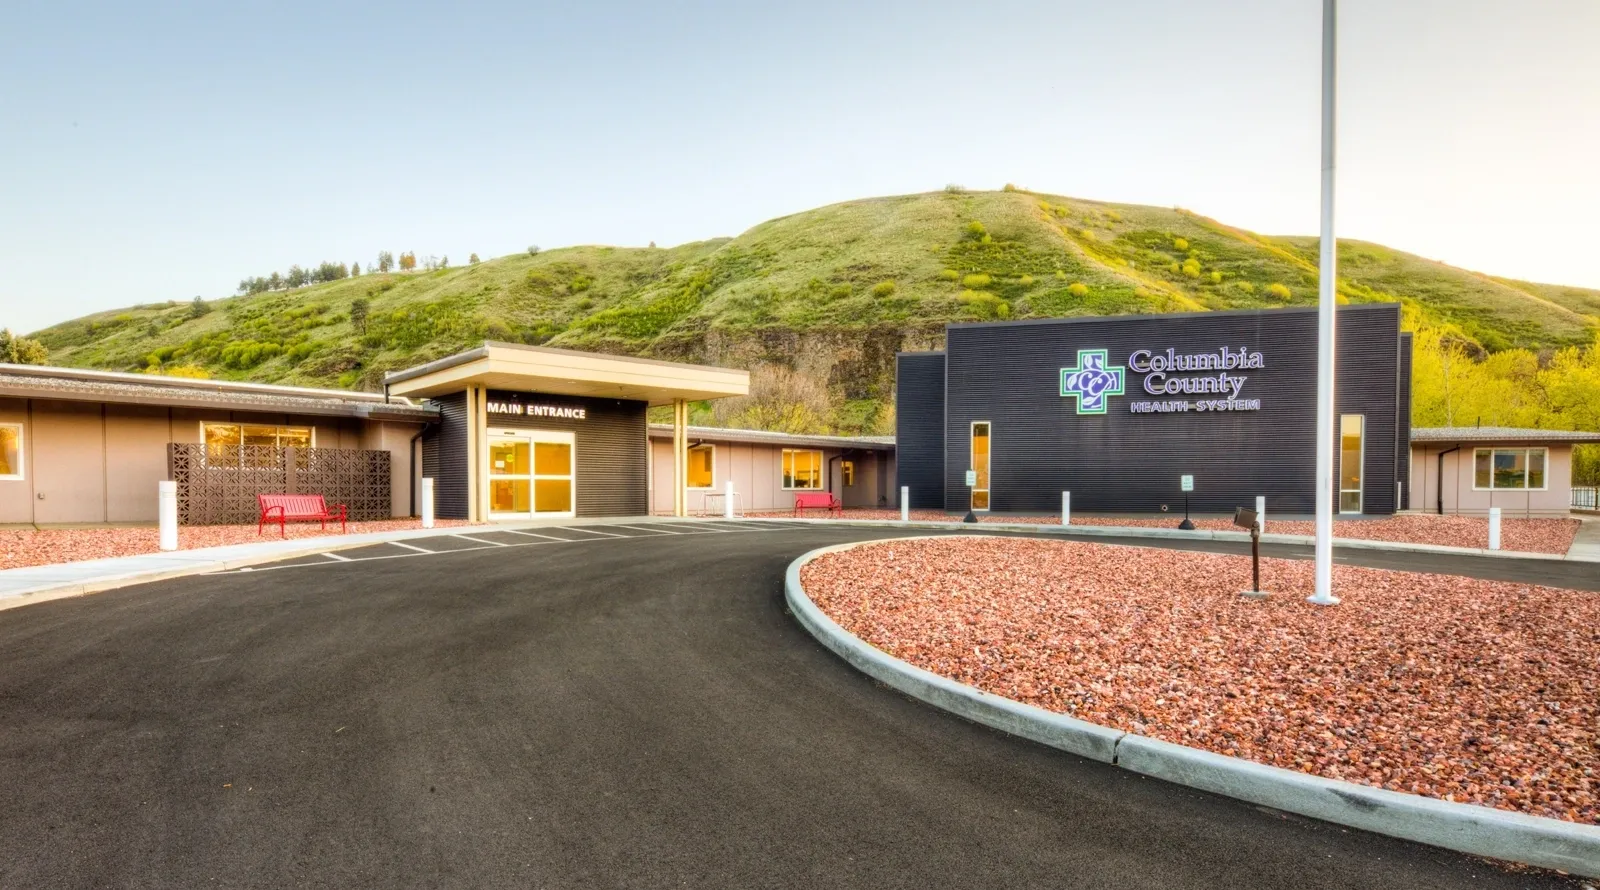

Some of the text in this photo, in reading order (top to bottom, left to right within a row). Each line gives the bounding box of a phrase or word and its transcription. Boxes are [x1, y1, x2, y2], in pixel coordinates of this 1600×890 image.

[1129, 346, 1264, 372] Columbia
[1143, 372, 1247, 400] County
[487, 402, 586, 419] MAIN ENTRANCE
[1130, 399, 1261, 413] HEALTH SYSTEM
